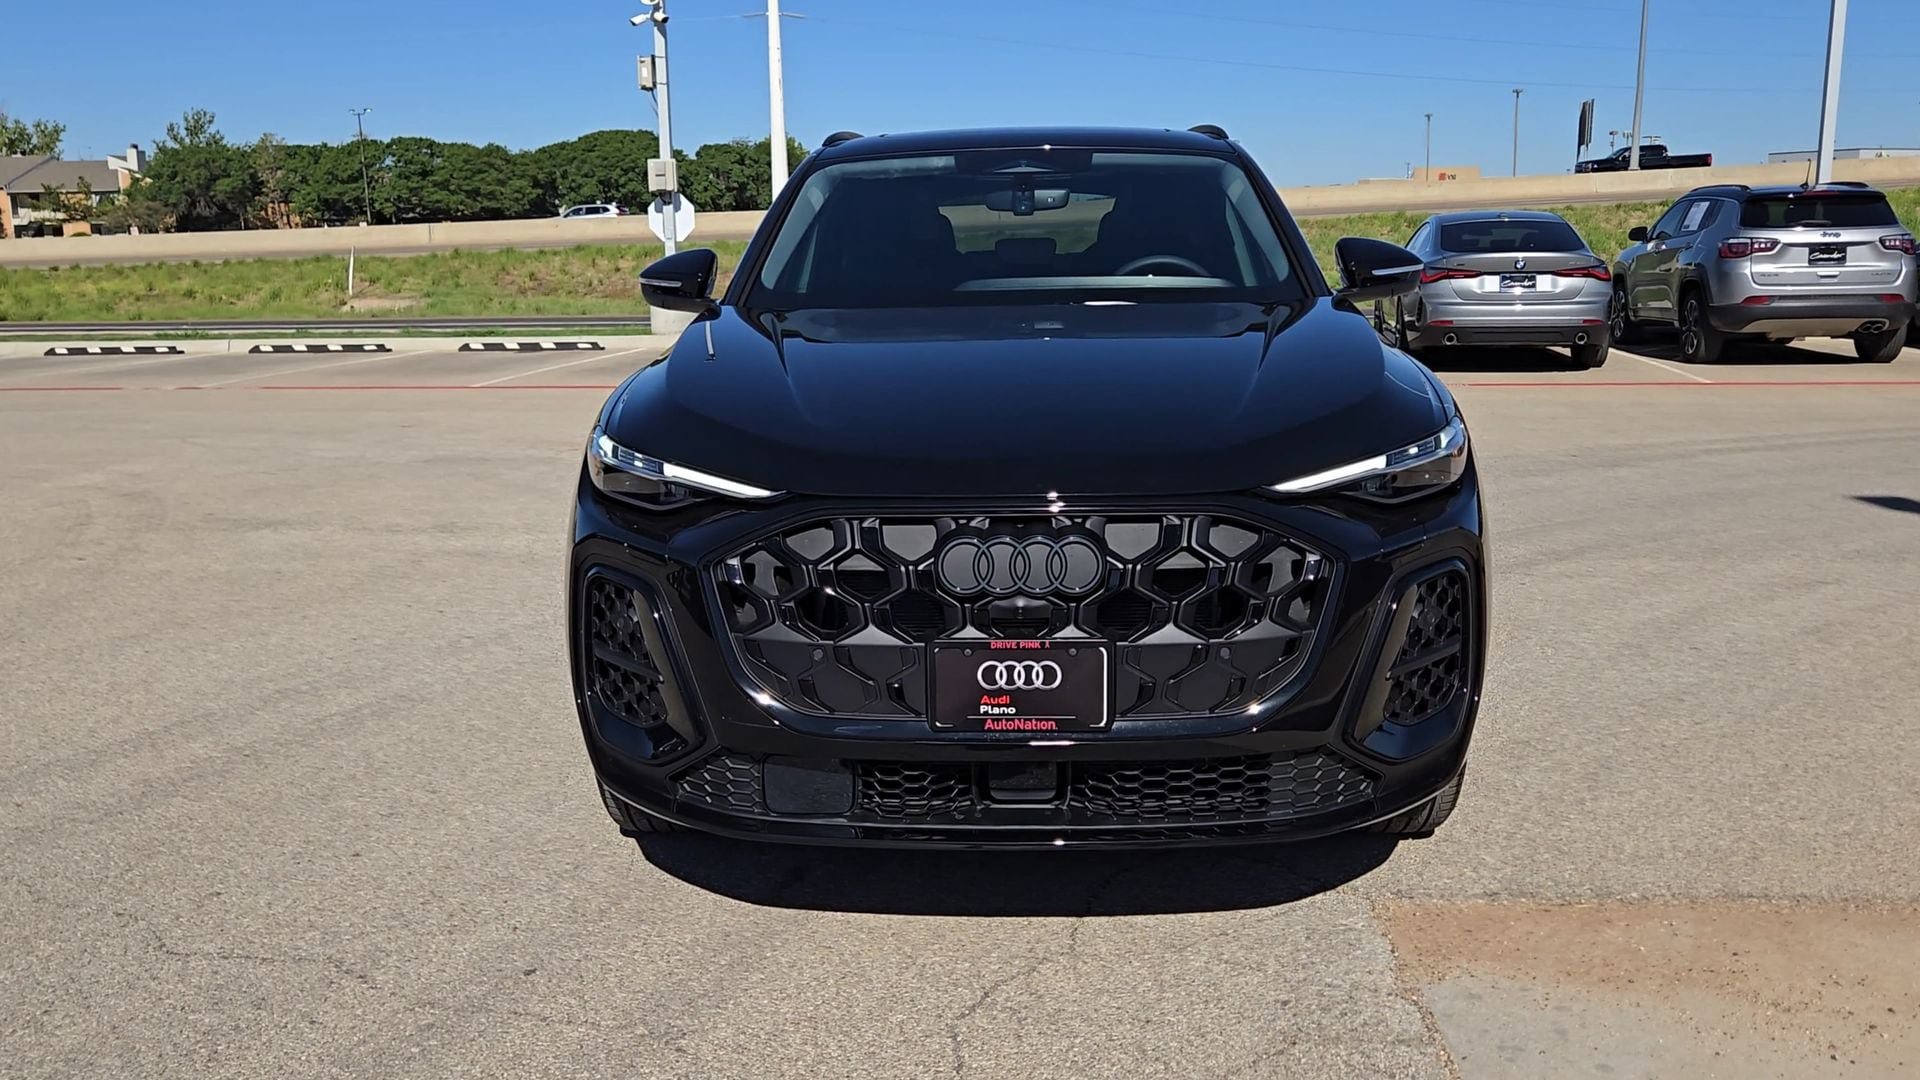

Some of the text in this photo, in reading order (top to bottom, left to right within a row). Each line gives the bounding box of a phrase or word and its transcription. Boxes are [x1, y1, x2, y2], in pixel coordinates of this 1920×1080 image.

[990, 640, 1041, 649] DRIVE PINK
[980, 695, 1010, 704] Audi
[980, 705, 1016, 714] Plano
